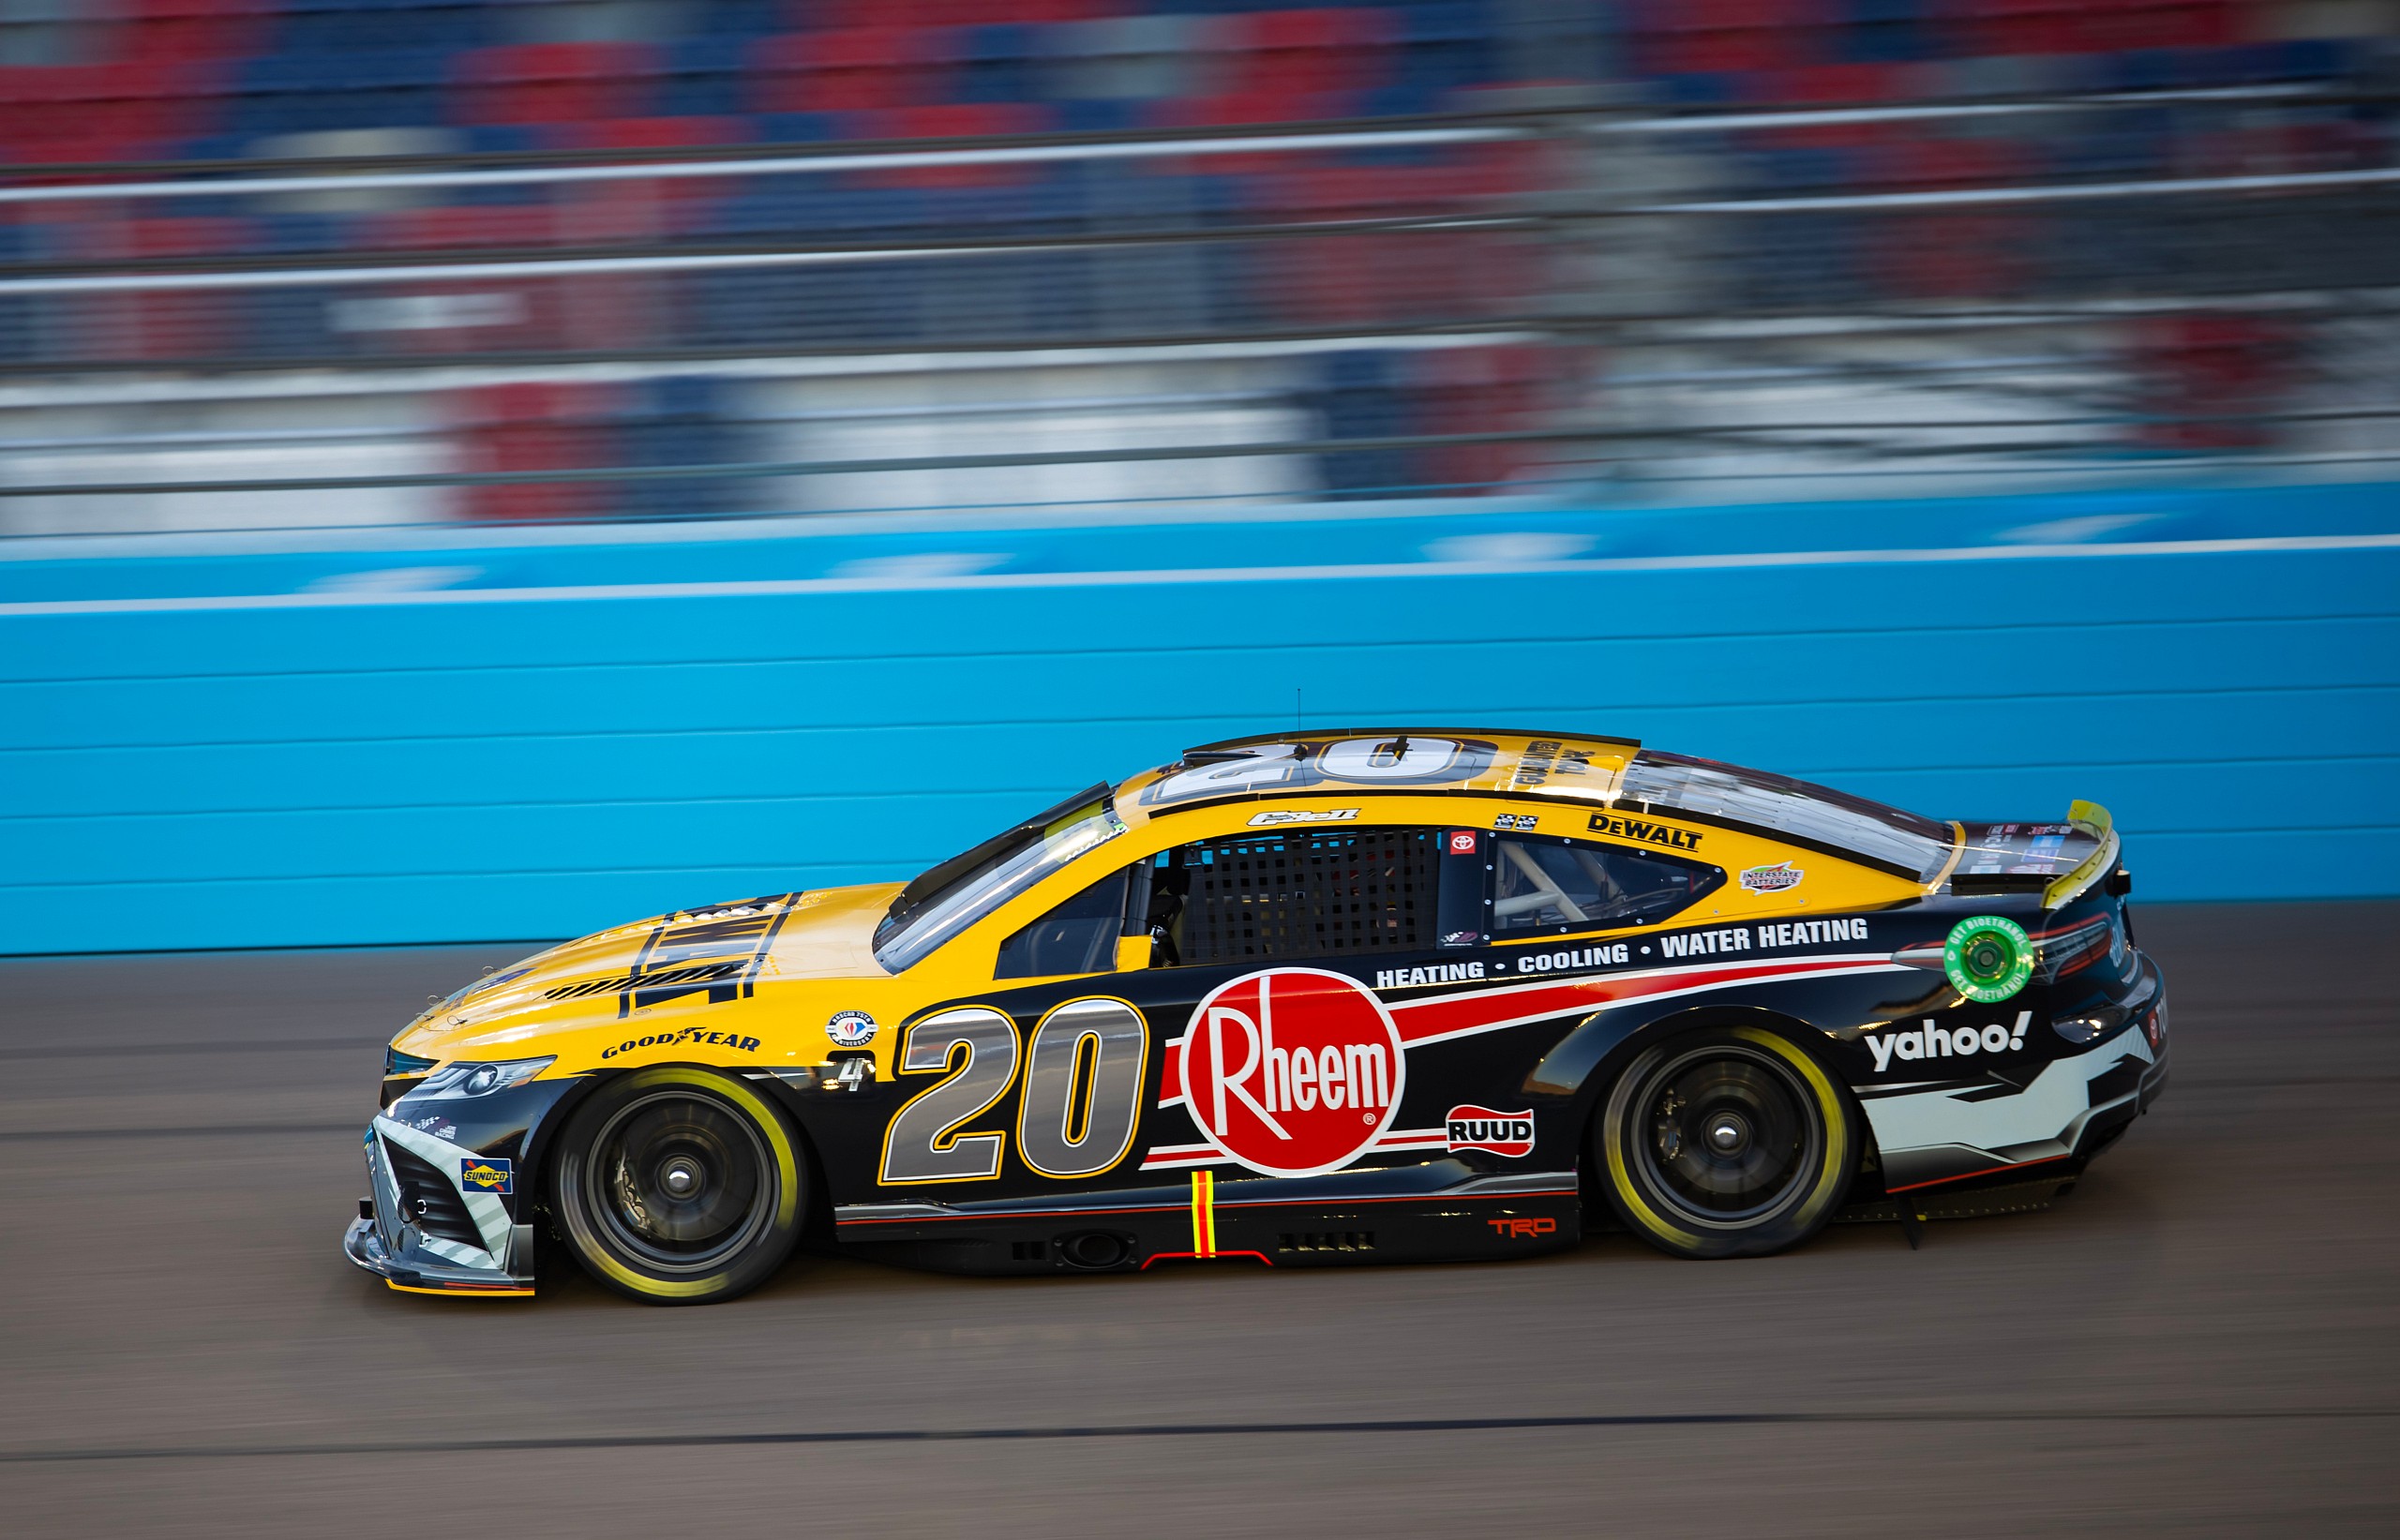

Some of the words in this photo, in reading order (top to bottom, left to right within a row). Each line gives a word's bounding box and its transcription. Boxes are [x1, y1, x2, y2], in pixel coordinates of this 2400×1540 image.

[1743, 871, 1800, 879] INTERSTATE
[1745, 877, 1797, 886] BATTERIES
[1949, 926, 1967, 945] GET
[1966, 918, 2028, 949] BIOETHANOL
[634, 893, 792, 1009] DWAT
[1377, 962, 1484, 988] HEATING
[1518, 944, 1629, 973] COOLING
[1660, 927, 1752, 958] WATER
[1760, 918, 1868, 949] HEATING
[831, 1033, 873, 1045] ANIVERSARY
[1864, 1010, 2032, 1072] yahoo!
[1208, 976, 1389, 1141] Rheem
[877, 994, 1150, 1186] 20
[1448, 1120, 1532, 1142] RUUD
[465, 1171, 507, 1182] SUNOCO
[1487, 1218, 1556, 1238] TRD
